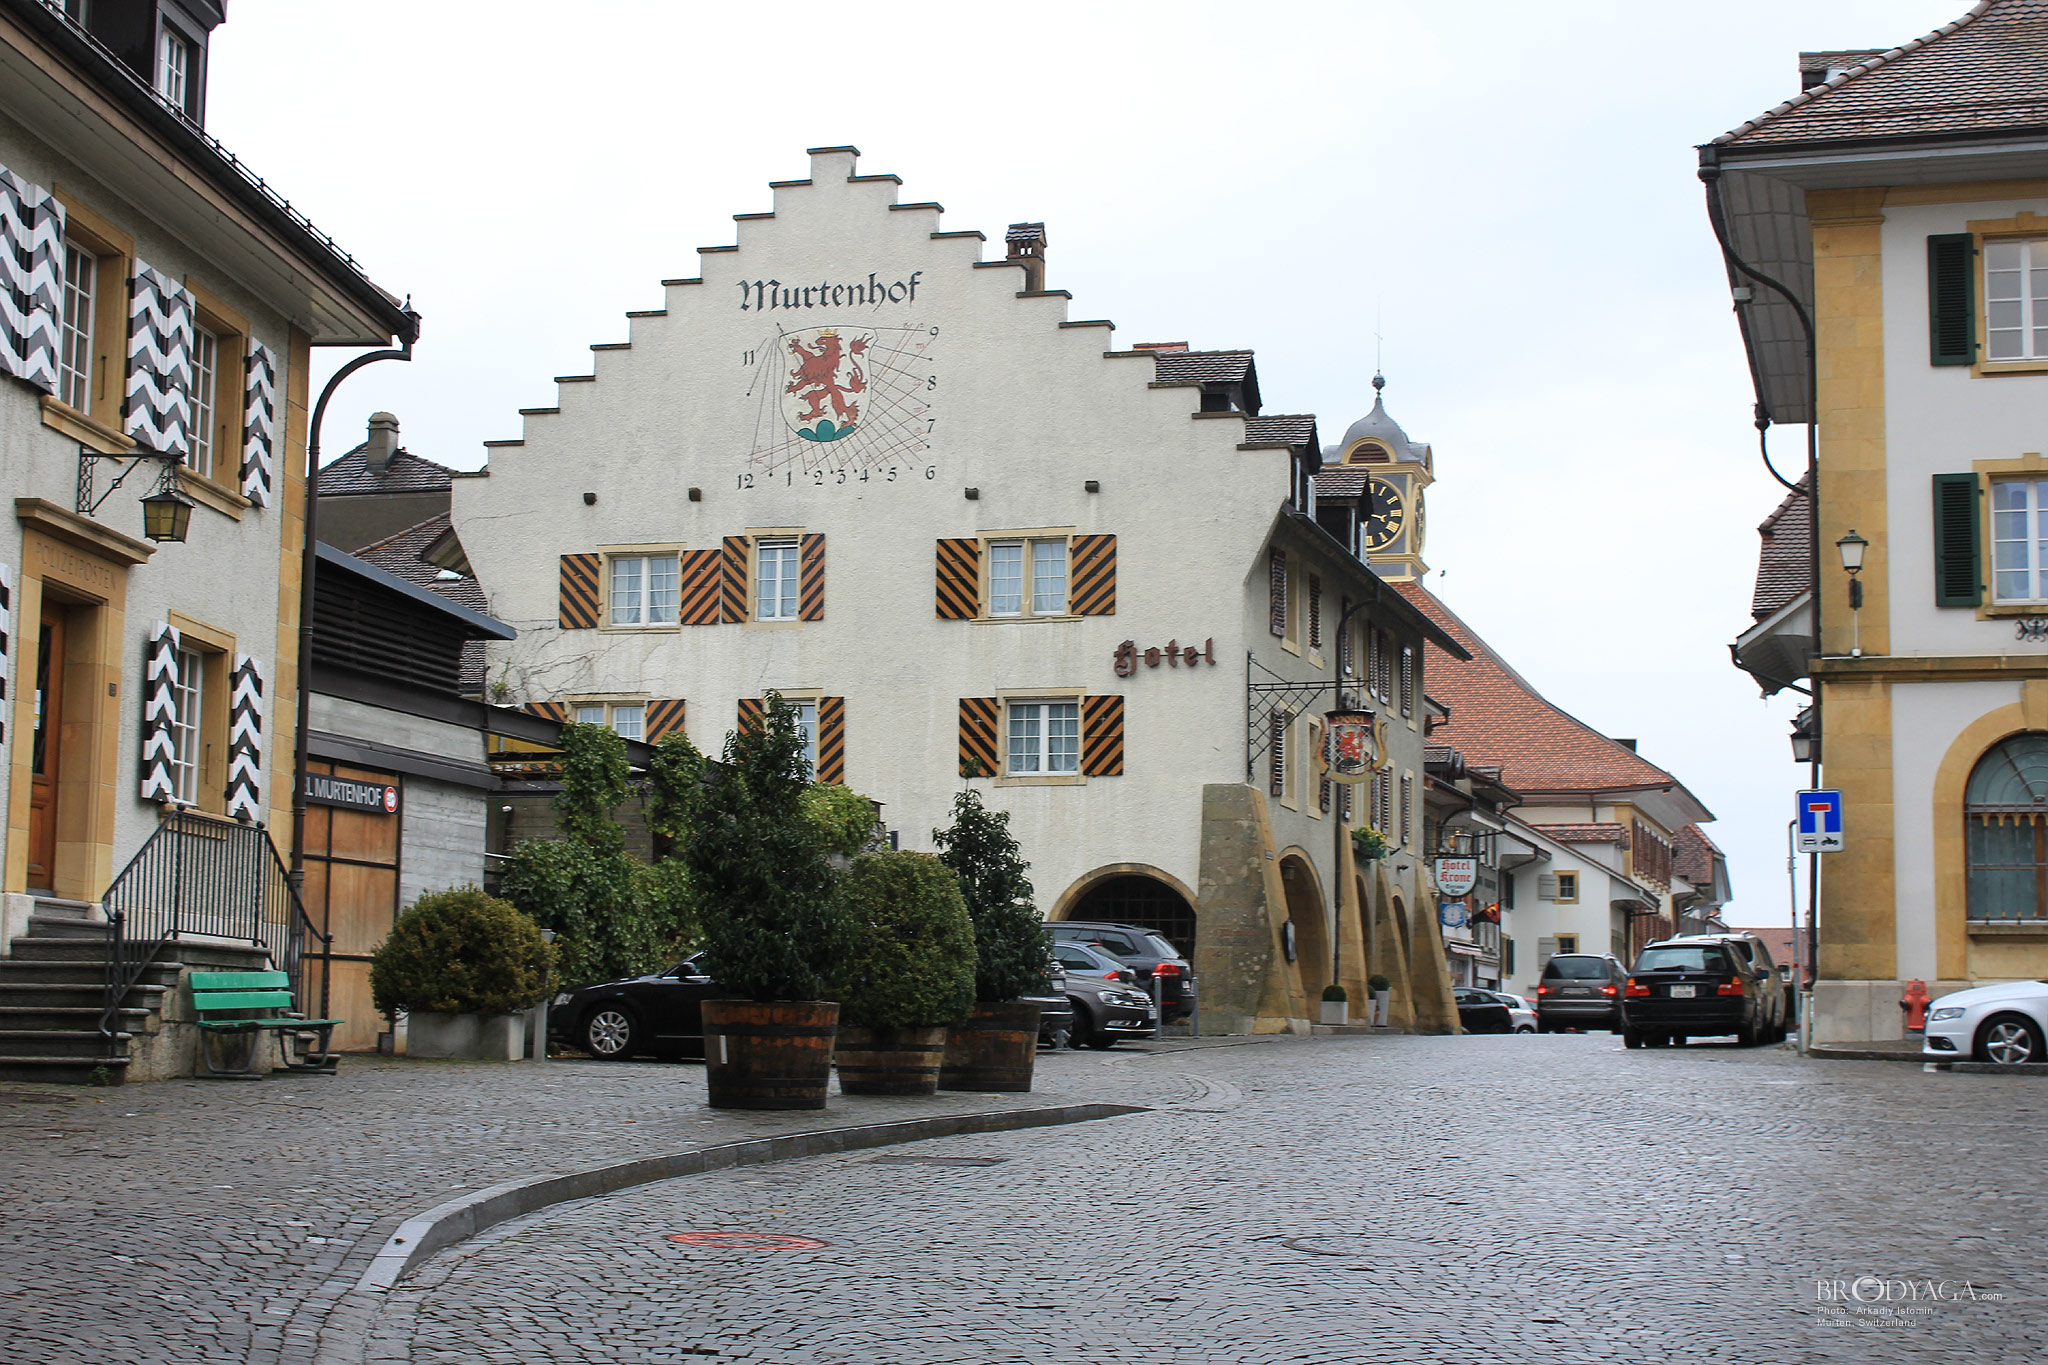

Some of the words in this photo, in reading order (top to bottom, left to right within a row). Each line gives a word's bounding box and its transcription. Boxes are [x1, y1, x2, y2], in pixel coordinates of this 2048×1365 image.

[736, 271, 923, 312] Murtenhof
[743, 350, 755, 367] 11
[926, 375, 938, 391] 8
[926, 418, 936, 434] 7
[737, 473, 755, 490] 12
[786, 470, 793, 488] 1
[813, 469, 824, 486] 2
[836, 469, 847, 485] 3
[859, 468, 870, 483] 4
[886, 466, 898, 483] 5
[925, 465, 936, 481] 6
[1113, 637, 1217, 678] Hotel
[314, 777, 382, 807] MURTENHOF
[1441, 859, 1471, 871] Hotel
[1440, 871, 1472, 882] Krone
